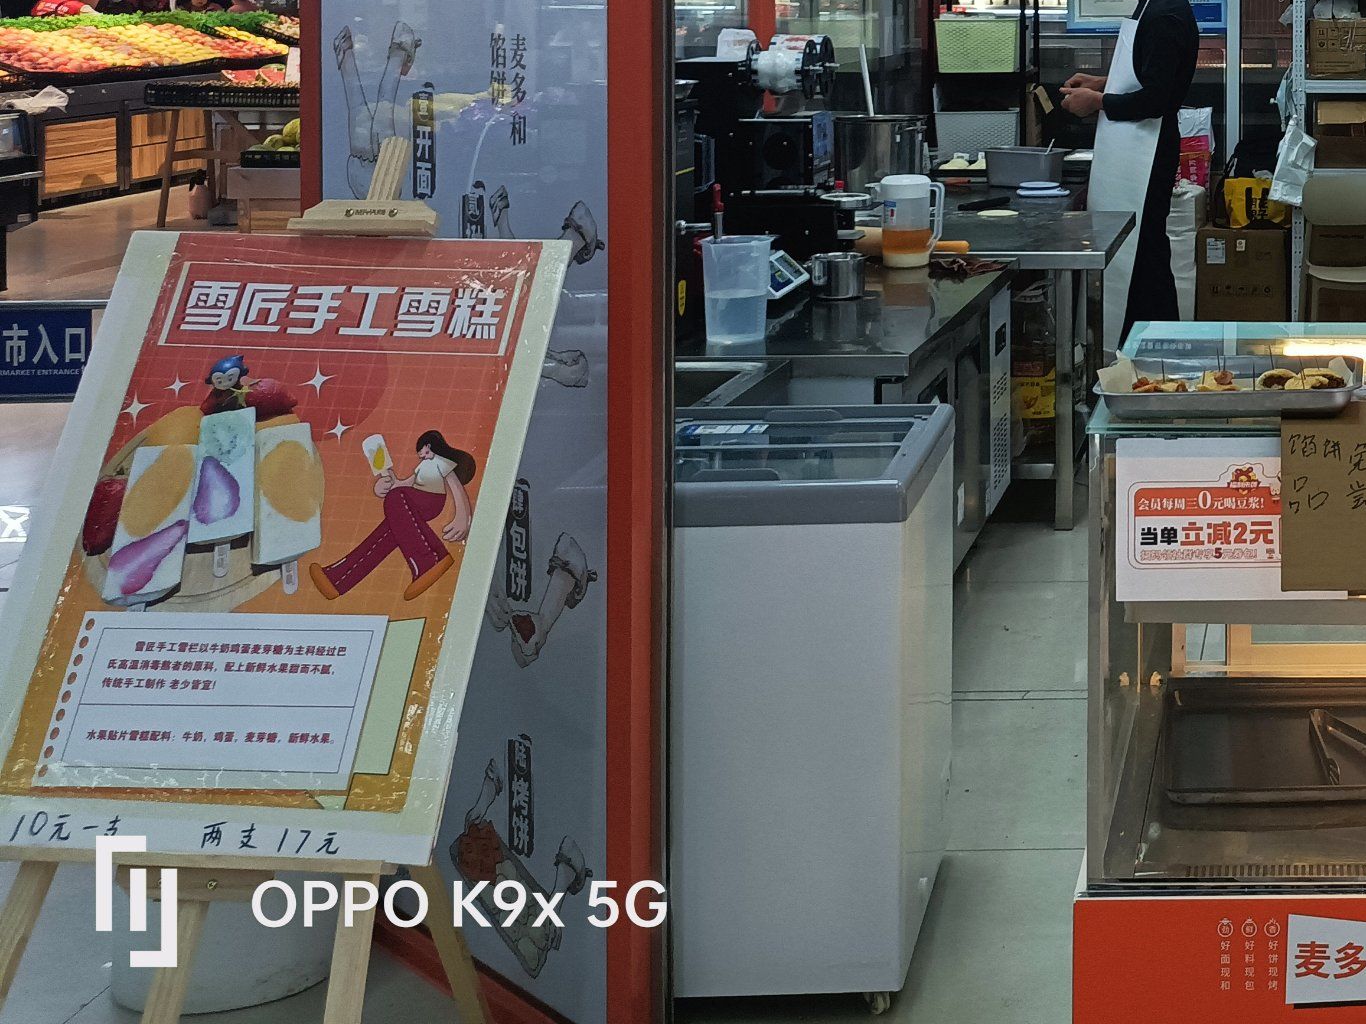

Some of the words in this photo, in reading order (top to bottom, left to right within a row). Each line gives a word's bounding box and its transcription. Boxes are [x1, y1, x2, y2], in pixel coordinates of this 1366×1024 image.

[489, 32, 507, 107] 馅饼
[509, 34, 527, 146] 麦多和
[416, 126, 432, 194] 开面
[178, 279, 505, 341] 雪匠手工雪糕
[2, 323, 86, 367] 市入口
[1140, 520, 1275, 546] 当单立减2元
